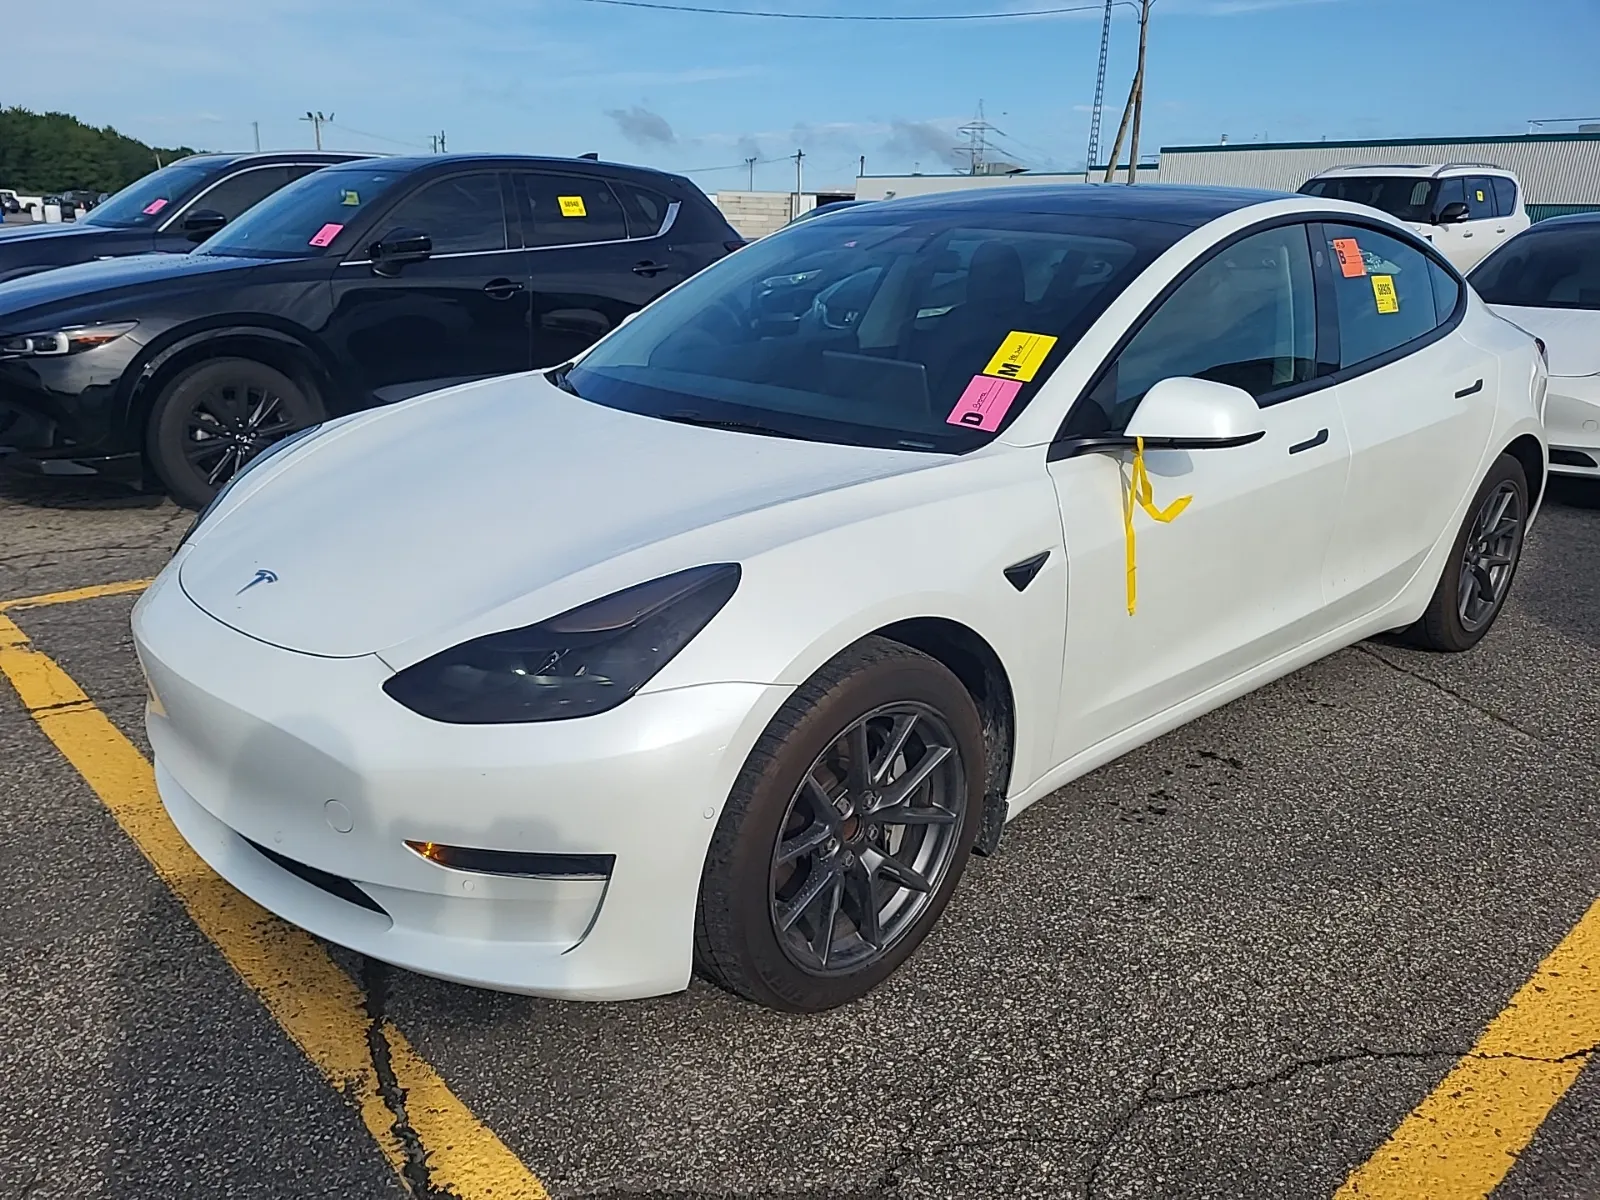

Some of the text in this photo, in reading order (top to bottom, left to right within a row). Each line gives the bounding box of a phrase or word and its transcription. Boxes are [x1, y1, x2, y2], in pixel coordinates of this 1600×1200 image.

[1337, 249, 1347, 265] B
[997, 362, 1022, 378] M
[960, 411, 984, 427] D
